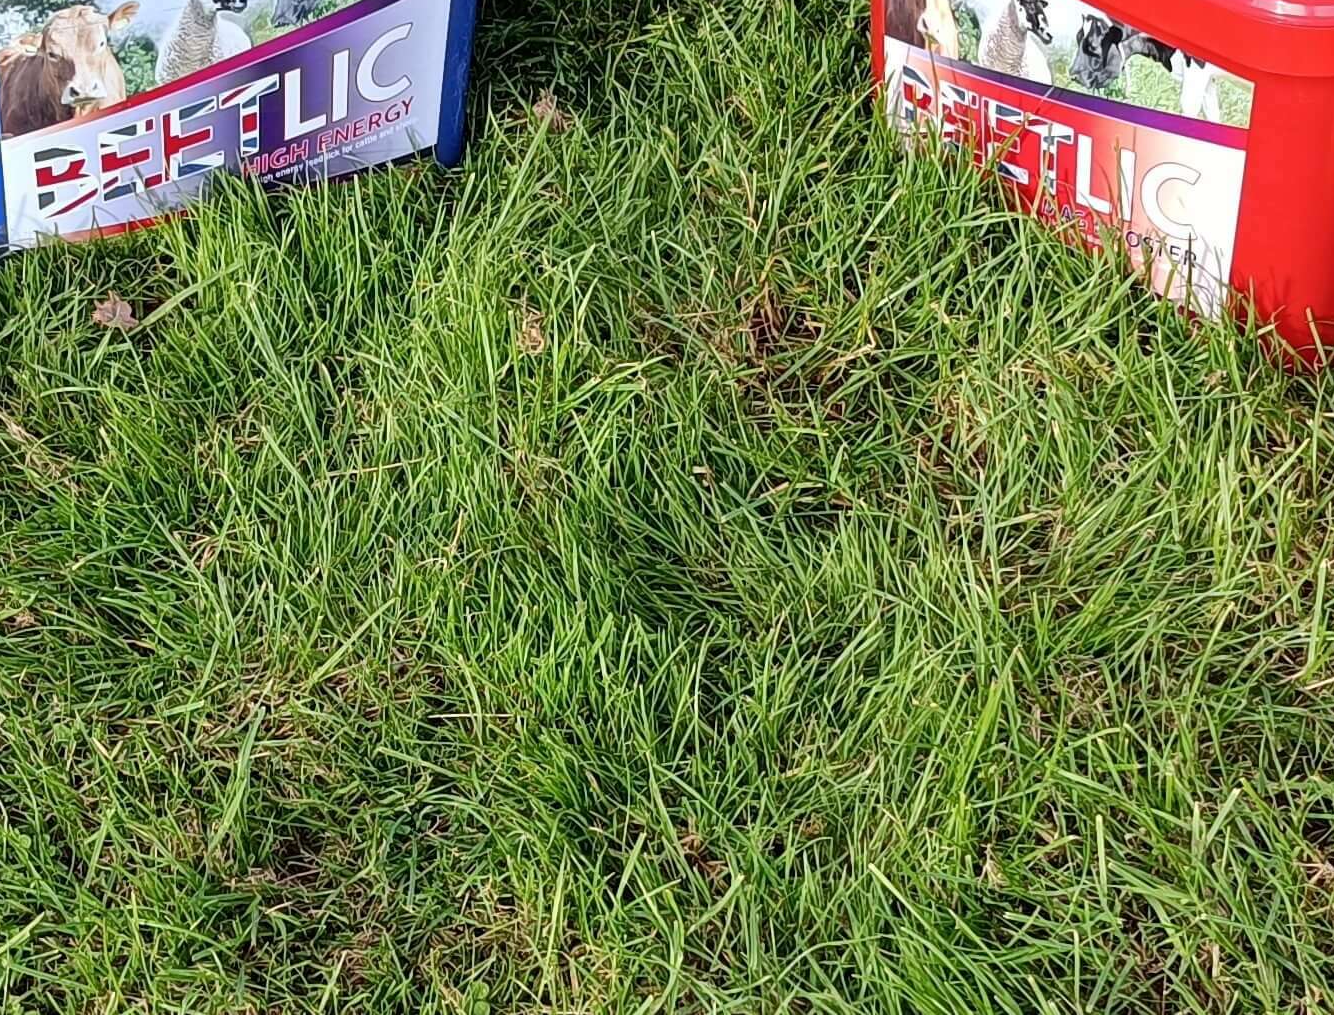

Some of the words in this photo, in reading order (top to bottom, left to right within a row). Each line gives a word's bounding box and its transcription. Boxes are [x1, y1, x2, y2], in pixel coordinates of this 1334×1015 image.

[33, 22, 413, 220] BEETLIC
[243, 138, 309, 178] HIGH
[317, 95, 414, 154] ENERGY
